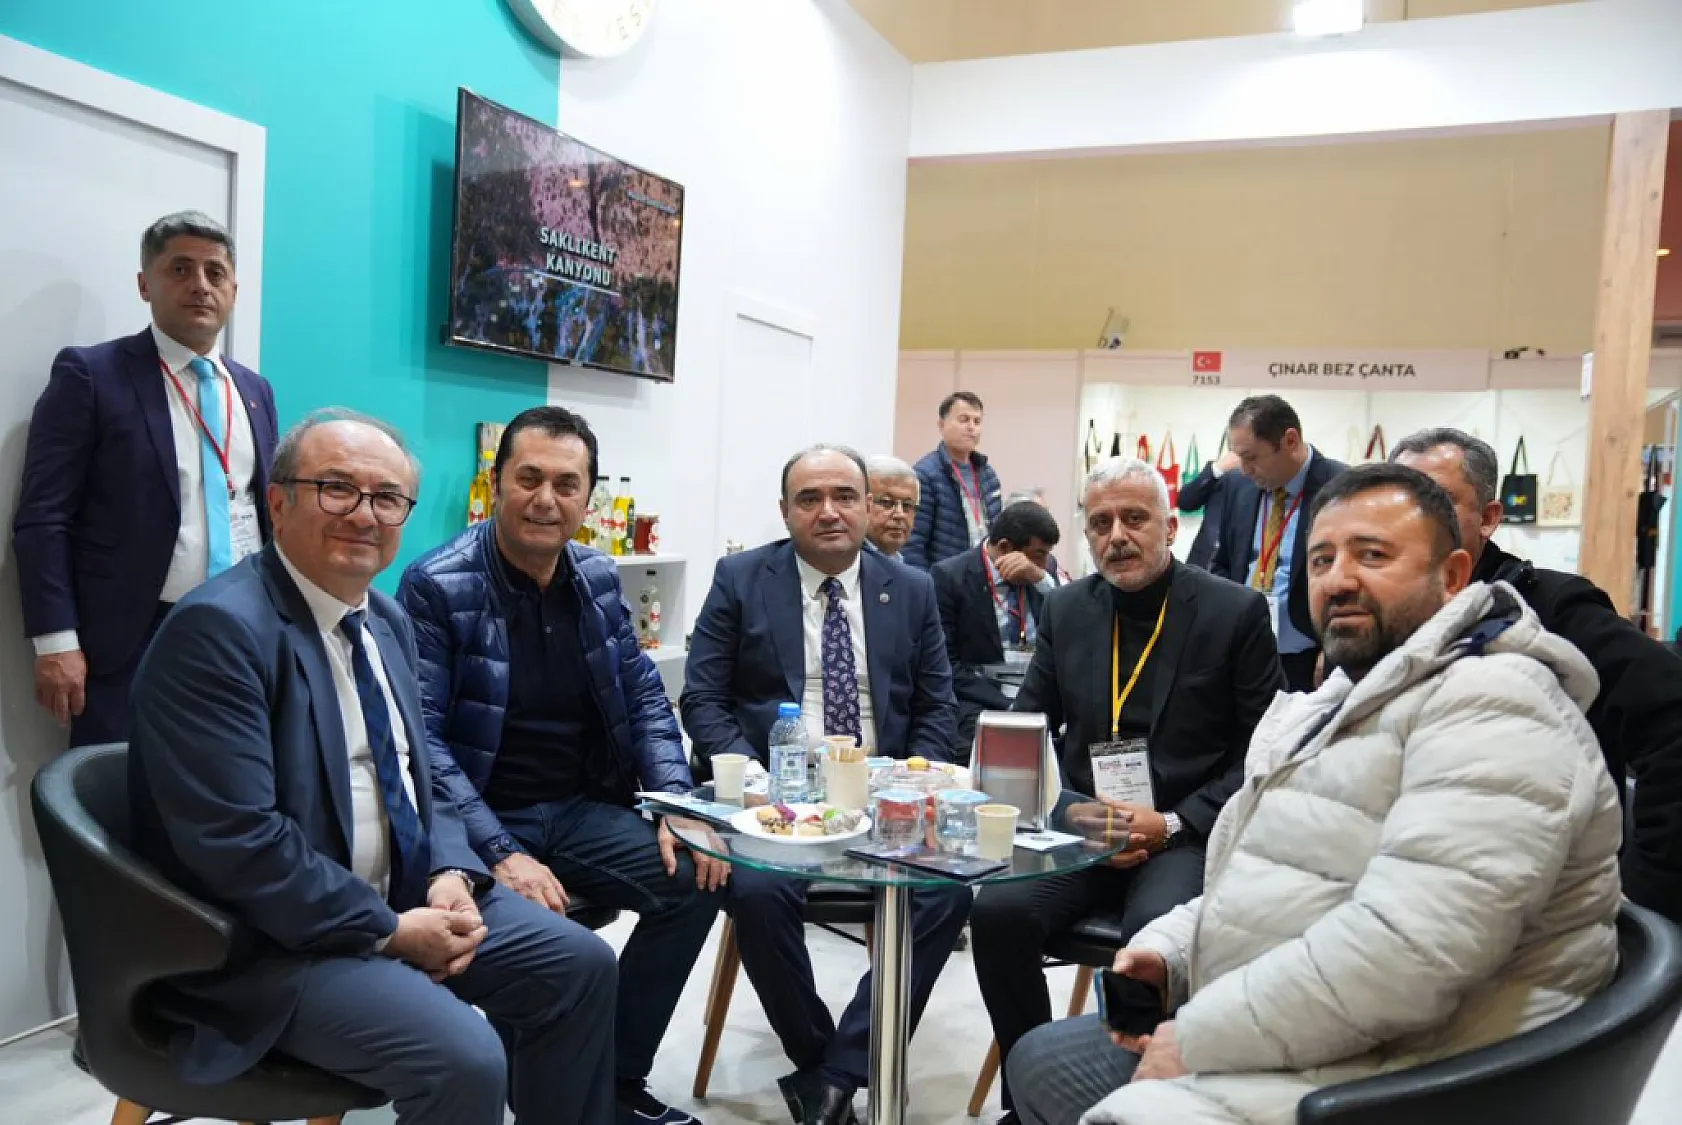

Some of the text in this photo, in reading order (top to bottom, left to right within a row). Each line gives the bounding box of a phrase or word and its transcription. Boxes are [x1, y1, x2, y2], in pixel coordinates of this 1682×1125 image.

[540, 226, 617, 264] SAKLIKENT
[546, 252, 611, 286] KANYONU
[1268, 362, 1417, 380] ÇINAR BEZ ÇANTA
